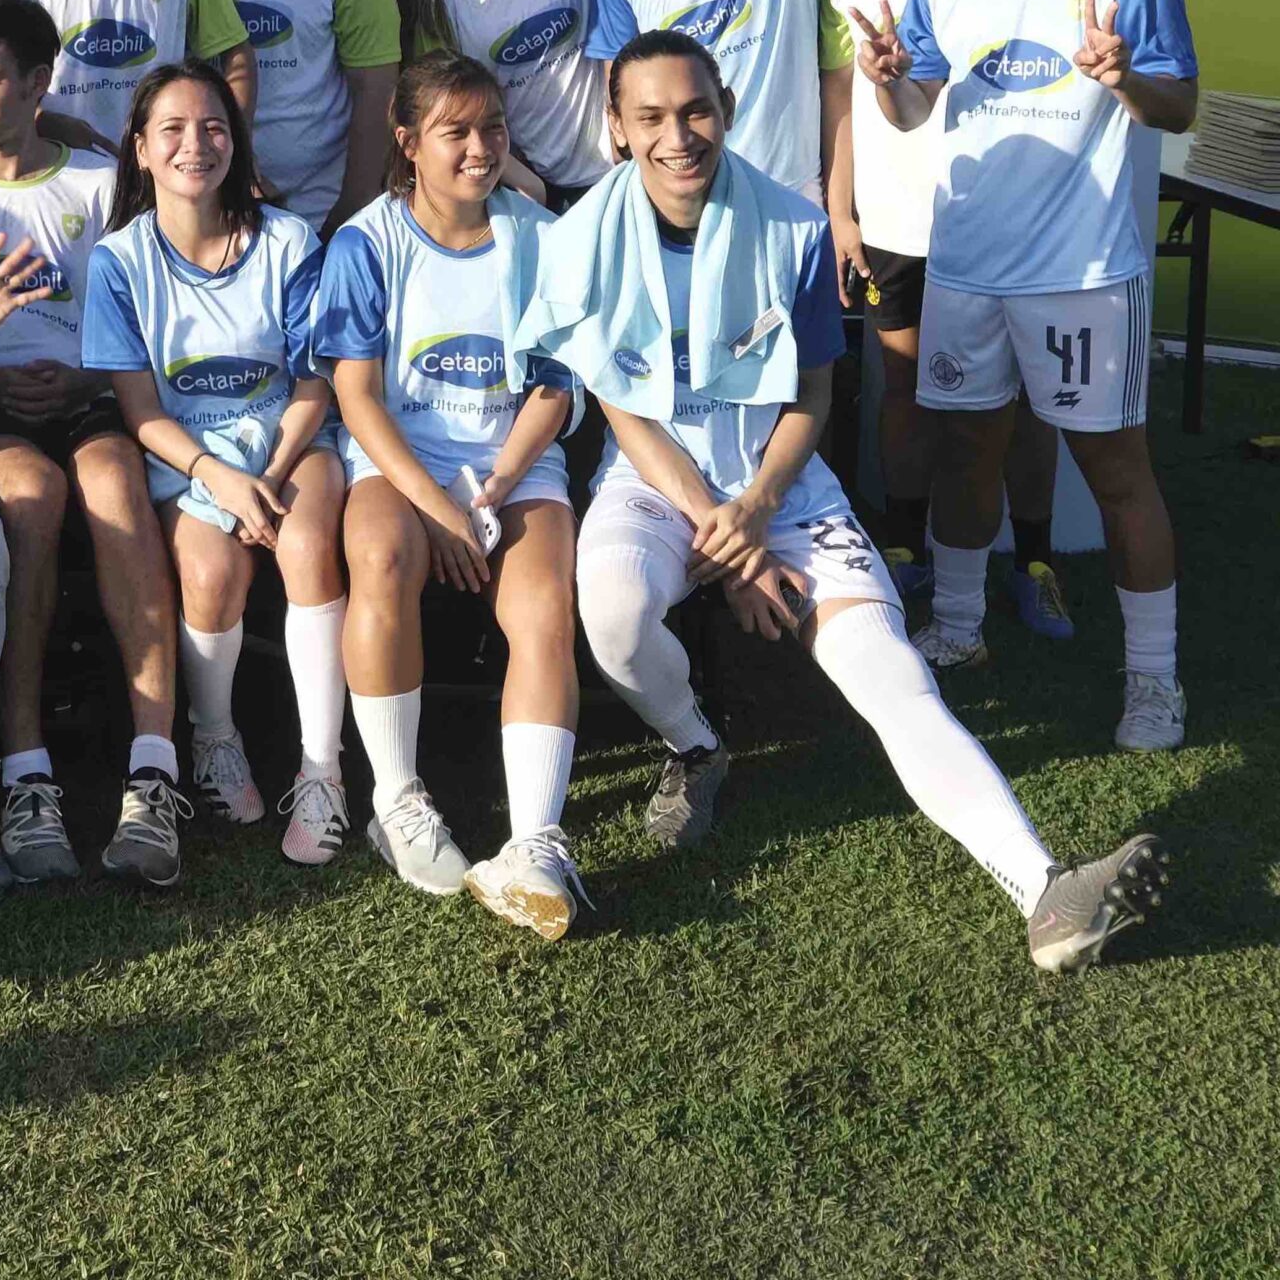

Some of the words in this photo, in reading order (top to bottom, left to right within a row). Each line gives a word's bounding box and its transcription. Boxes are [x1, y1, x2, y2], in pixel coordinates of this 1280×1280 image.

[502, 10, 572, 62] Cetaphil
[421, 351, 504, 377] Cetaph
[1046, 325, 1091, 385] 41
[177, 366, 268, 391] Cetaphil
